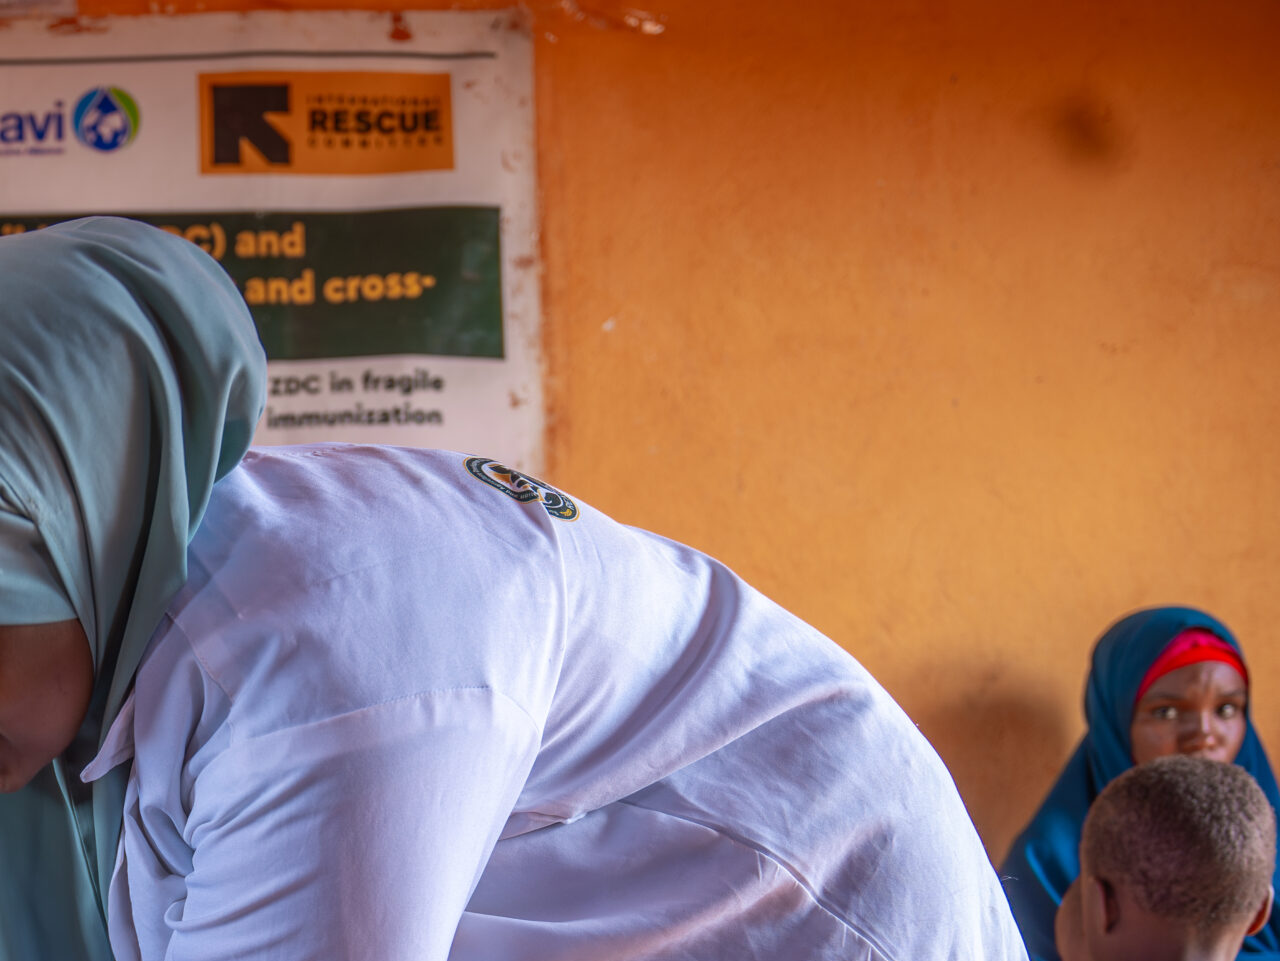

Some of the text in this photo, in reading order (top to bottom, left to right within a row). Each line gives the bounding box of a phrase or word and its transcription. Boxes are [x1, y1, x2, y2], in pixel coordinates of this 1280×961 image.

[308, 108, 441, 134] RESCUE
[235, 222, 306, 258] and
[244, 268, 315, 304] and
[323, 271, 437, 303] cross-
[271, 375, 320, 395] ZDC
[330, 371, 354, 392] in
[363, 367, 444, 395] fragile
[267, 402, 443, 429] immunization
